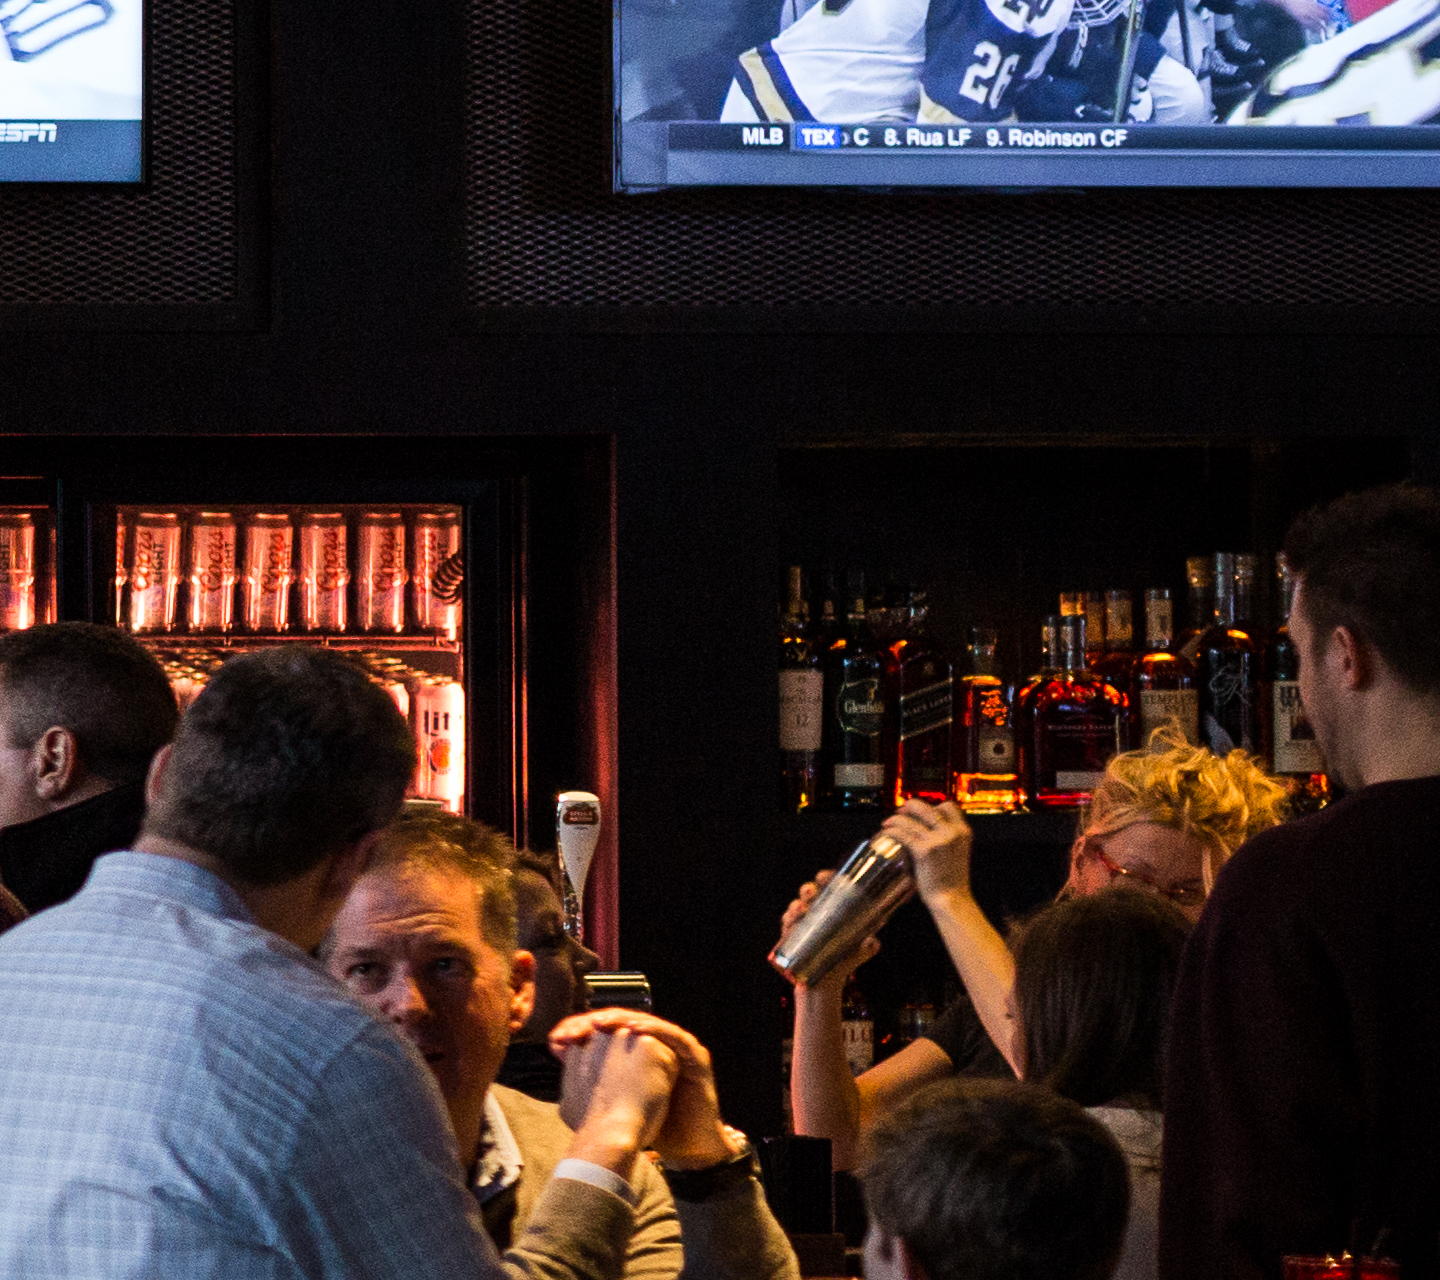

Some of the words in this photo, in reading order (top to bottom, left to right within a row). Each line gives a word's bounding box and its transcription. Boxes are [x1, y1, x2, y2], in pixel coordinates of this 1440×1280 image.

[742, 127, 784, 145] MLB
[800, 128, 836, 146] TEX
[854, 128, 870, 146] C
[884, 128, 902, 147] 8.
[906, 128, 945, 147] Rua
[948, 128, 973, 147] LF
[986, 128, 1004, 147] 9.
[1007, 128, 1097, 148] Robinson
[1100, 129, 1128, 148] CF
